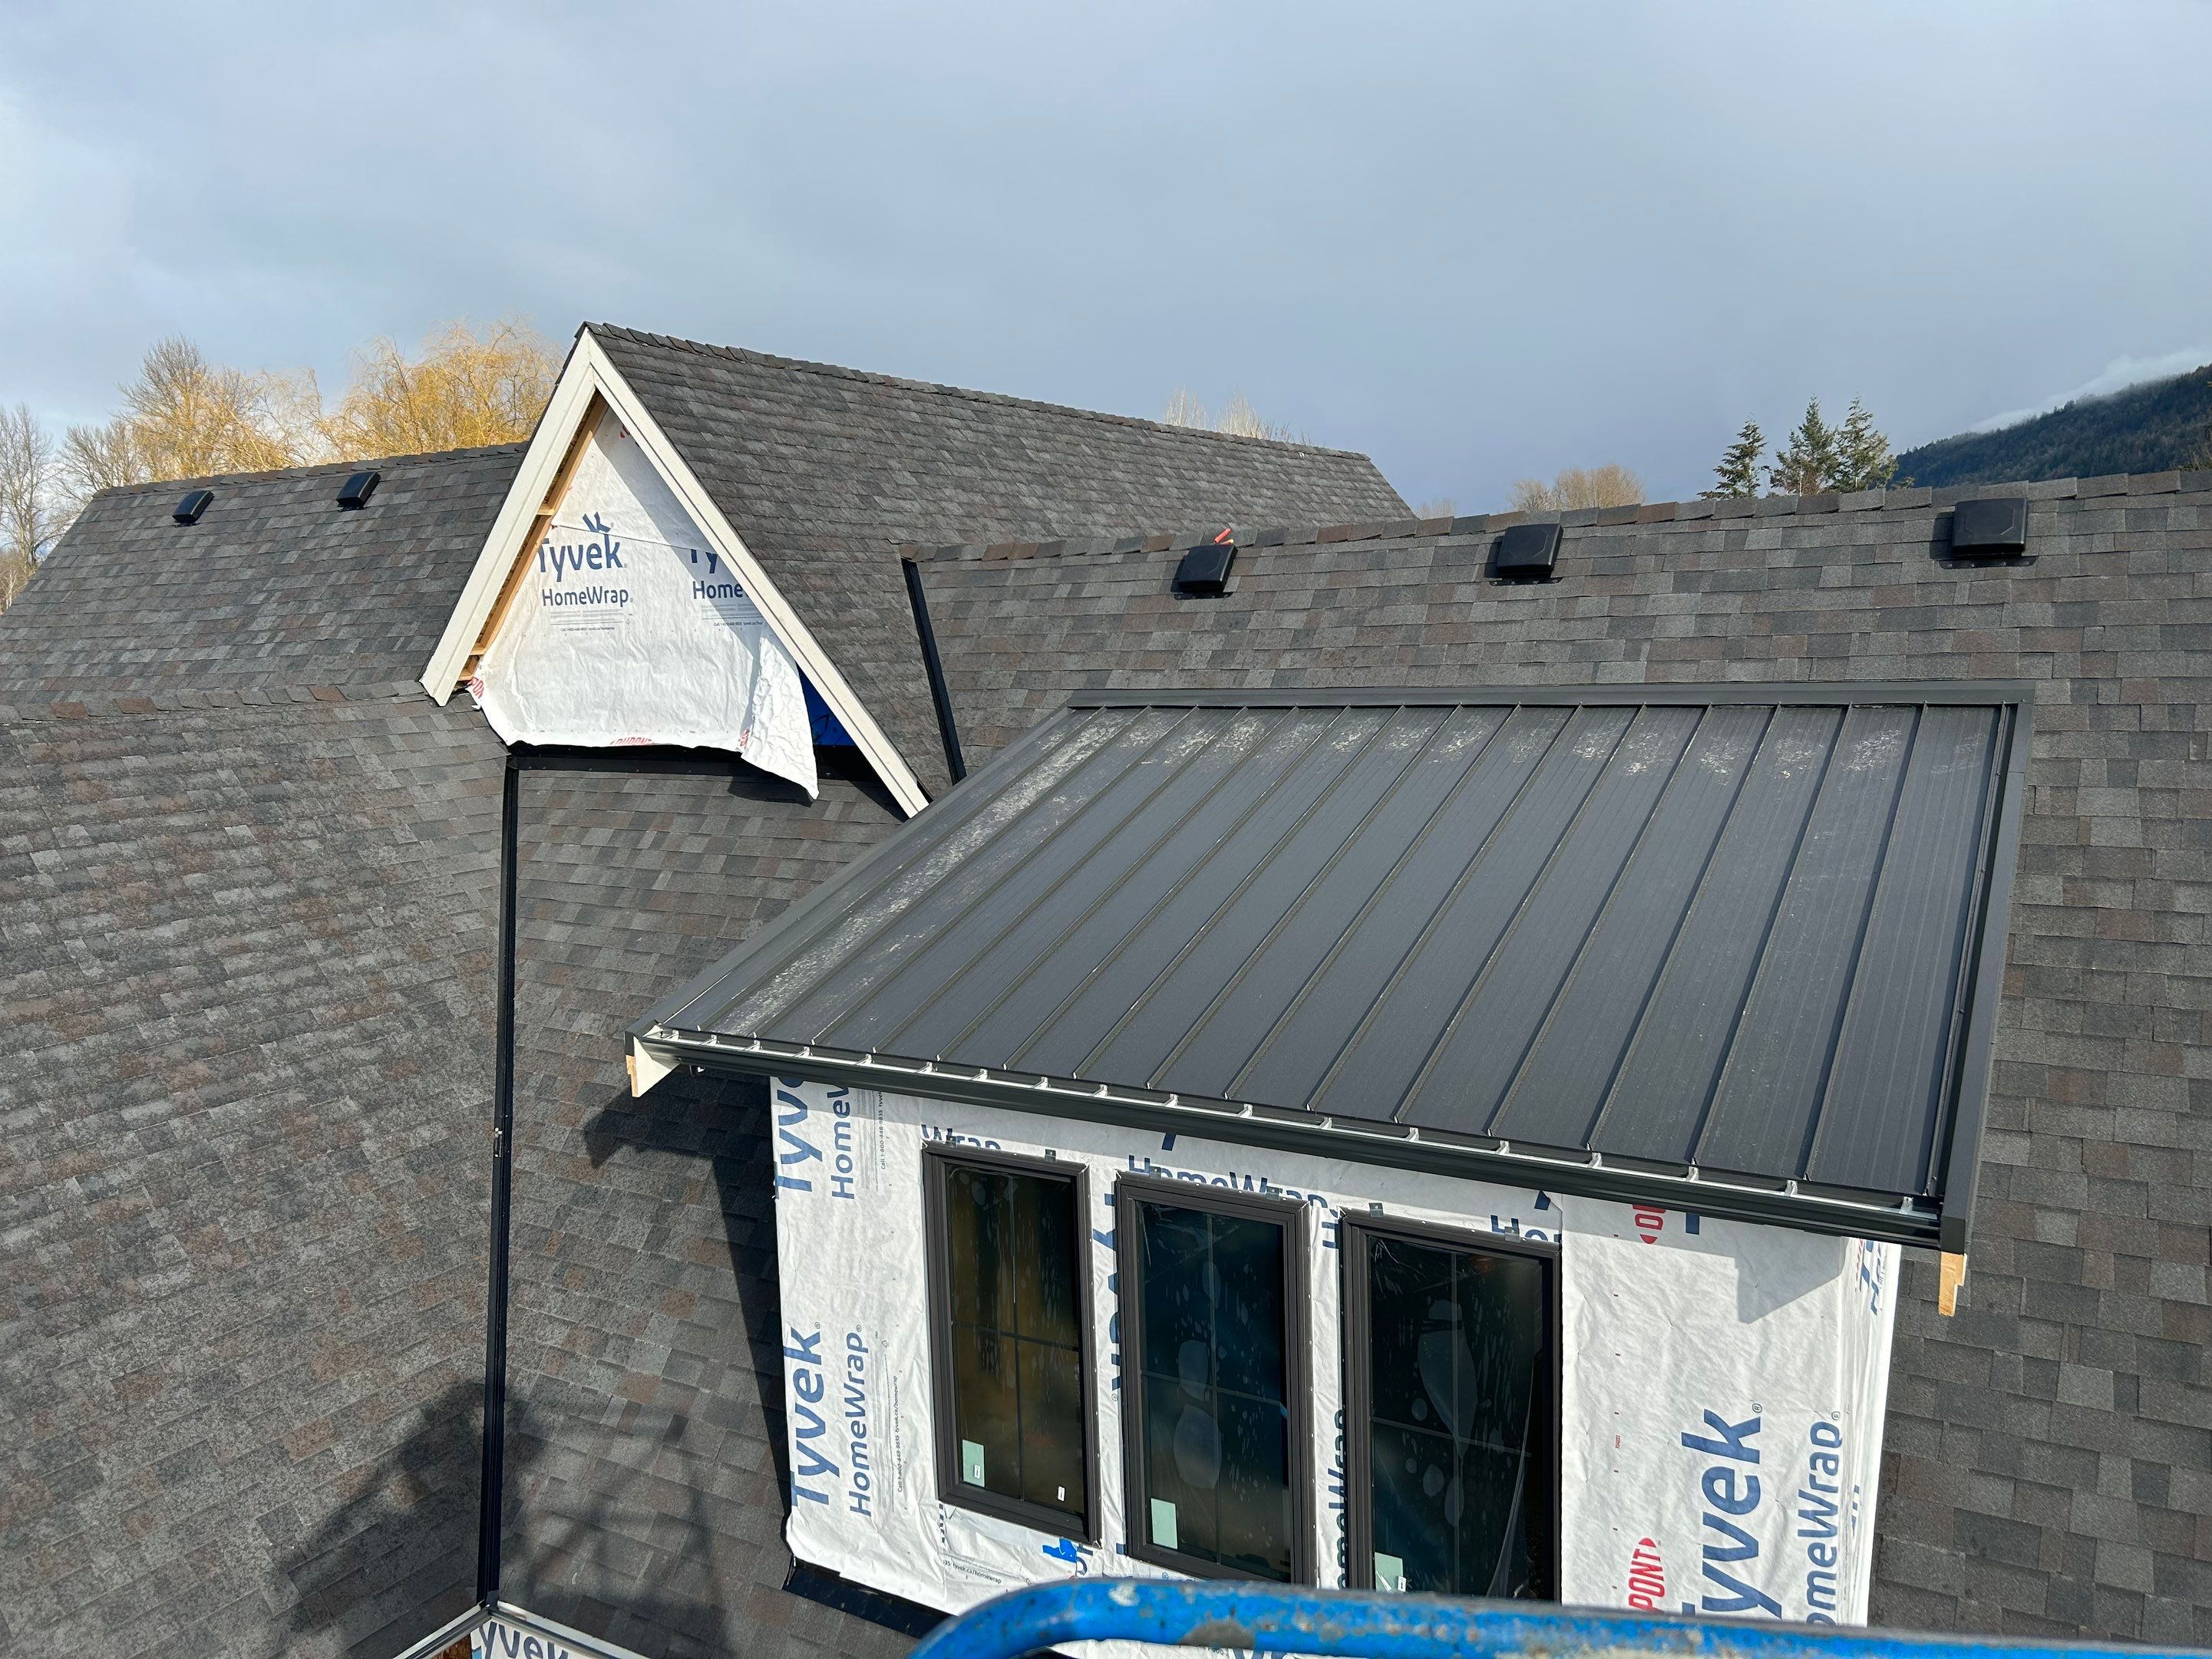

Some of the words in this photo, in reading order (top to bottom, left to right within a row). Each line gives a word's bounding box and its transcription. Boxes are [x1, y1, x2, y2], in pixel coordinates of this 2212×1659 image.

[542, 586, 629, 607] HomeWrap
[774, 1077, 823, 1199] Tyv
[783, 1327, 840, 1506] Tyvek
[844, 1332, 871, 1517] HomeWrap
[1682, 1409, 1782, 1618] yvek
